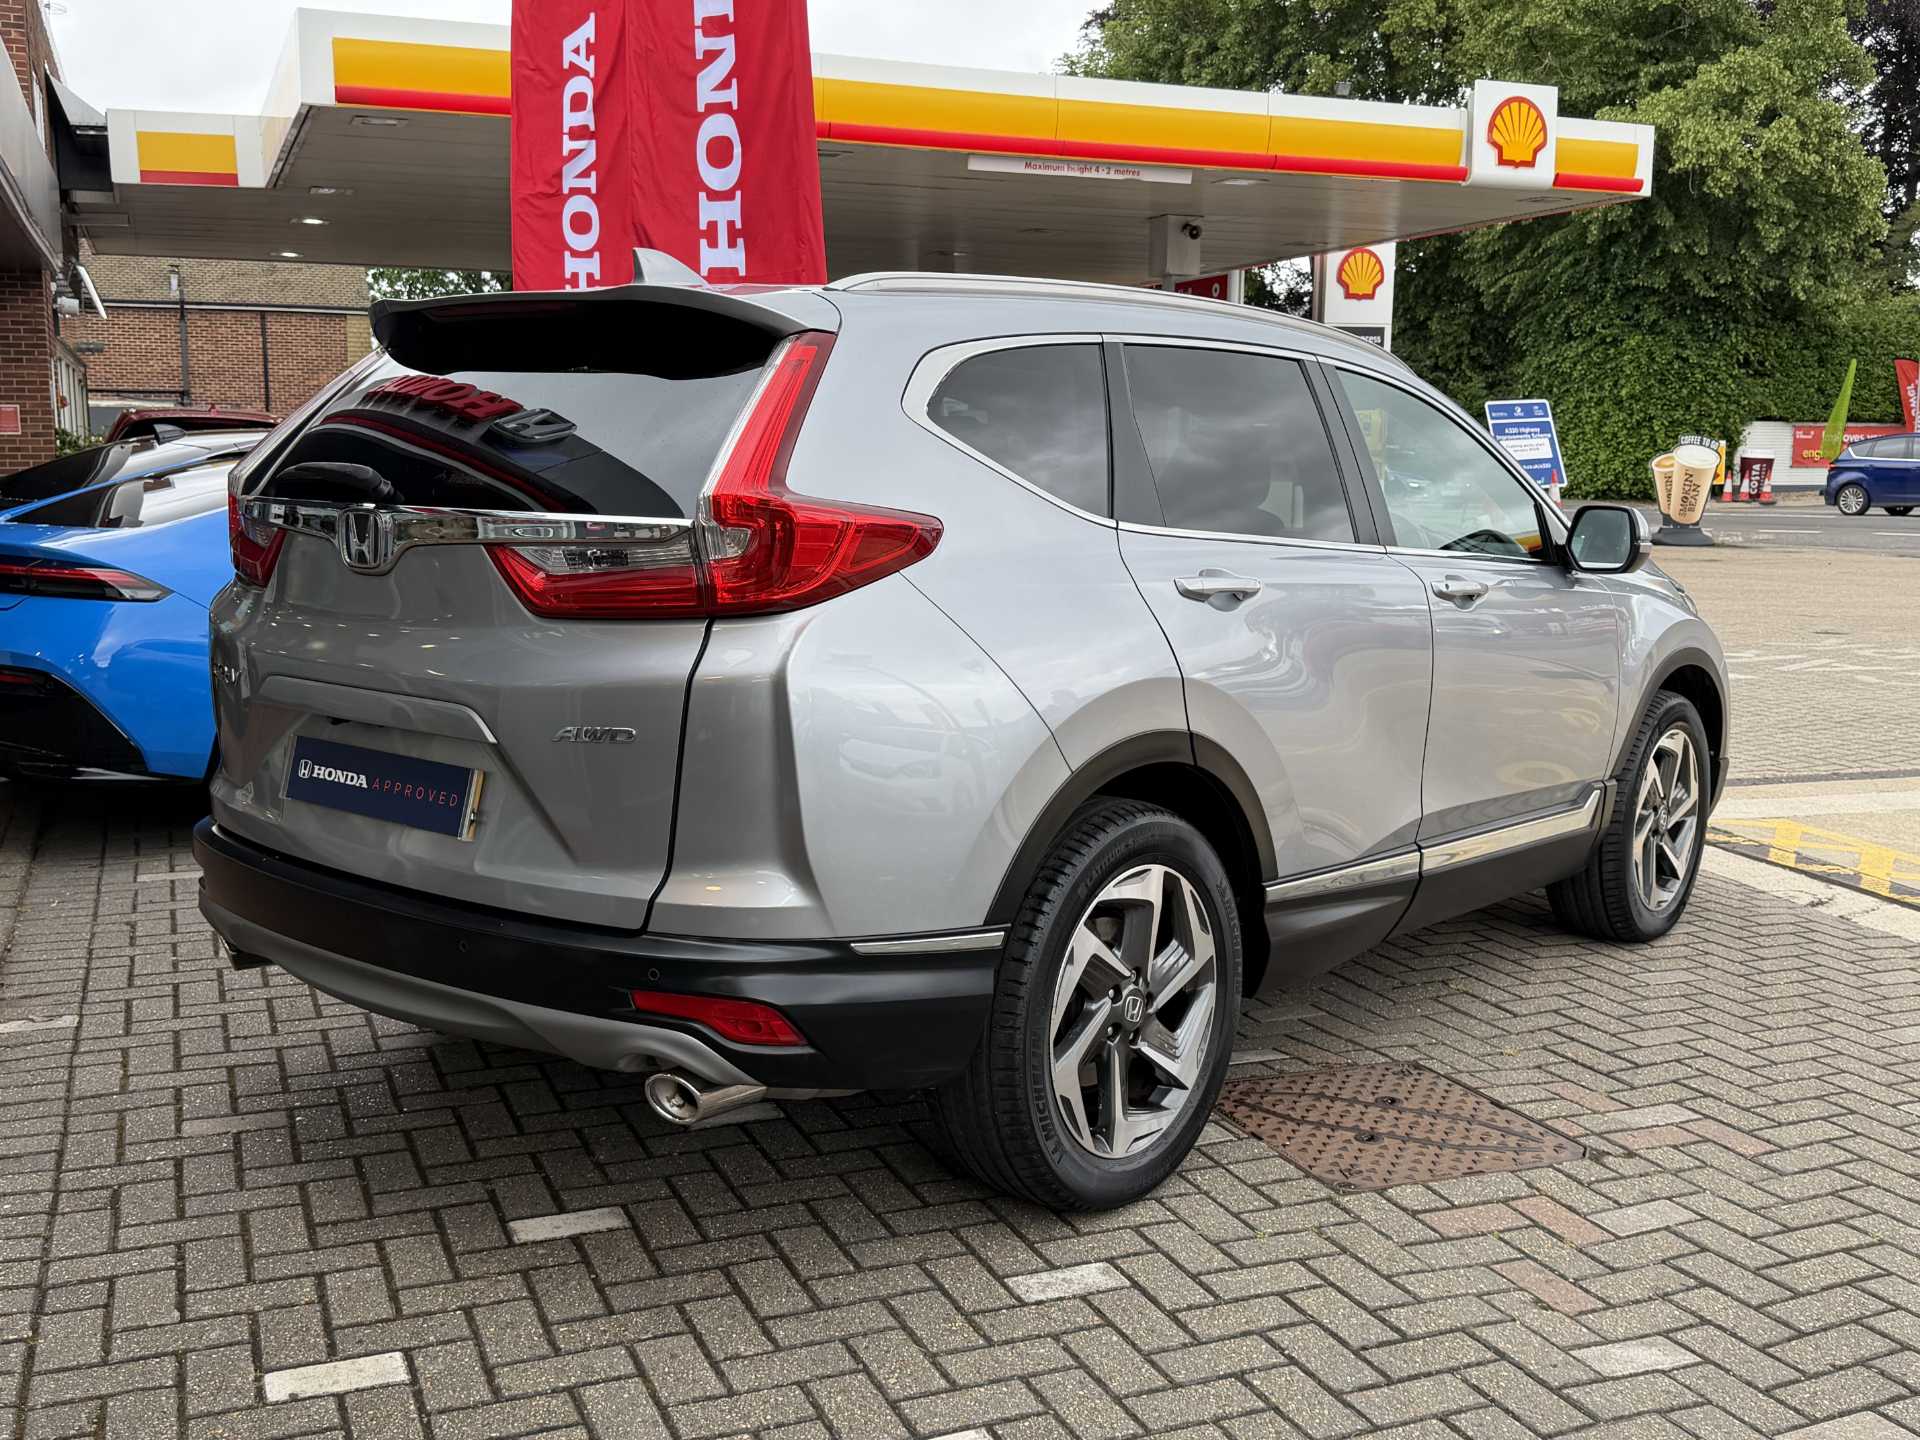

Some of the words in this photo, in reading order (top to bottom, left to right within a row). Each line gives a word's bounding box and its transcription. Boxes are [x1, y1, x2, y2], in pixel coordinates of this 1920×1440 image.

[561, 12, 600, 290] HONDA
[693, 0, 746, 277] HON
[1024, 161, 1064, 172] Maximum
[1067, 163, 1092, 174] height
[1114, 167, 1140, 177] metres
[1680, 435, 1702, 445] COFFEE
[1703, 437, 1711, 447] TO
[1710, 440, 1719, 450] GO
[1750, 463, 1761, 495] COSTA
[1688, 483, 1701, 512] BEAN
[552, 726, 636, 743] AWD
[312, 765, 368, 789] HONDA
[371, 777, 459, 807] APPROVED
